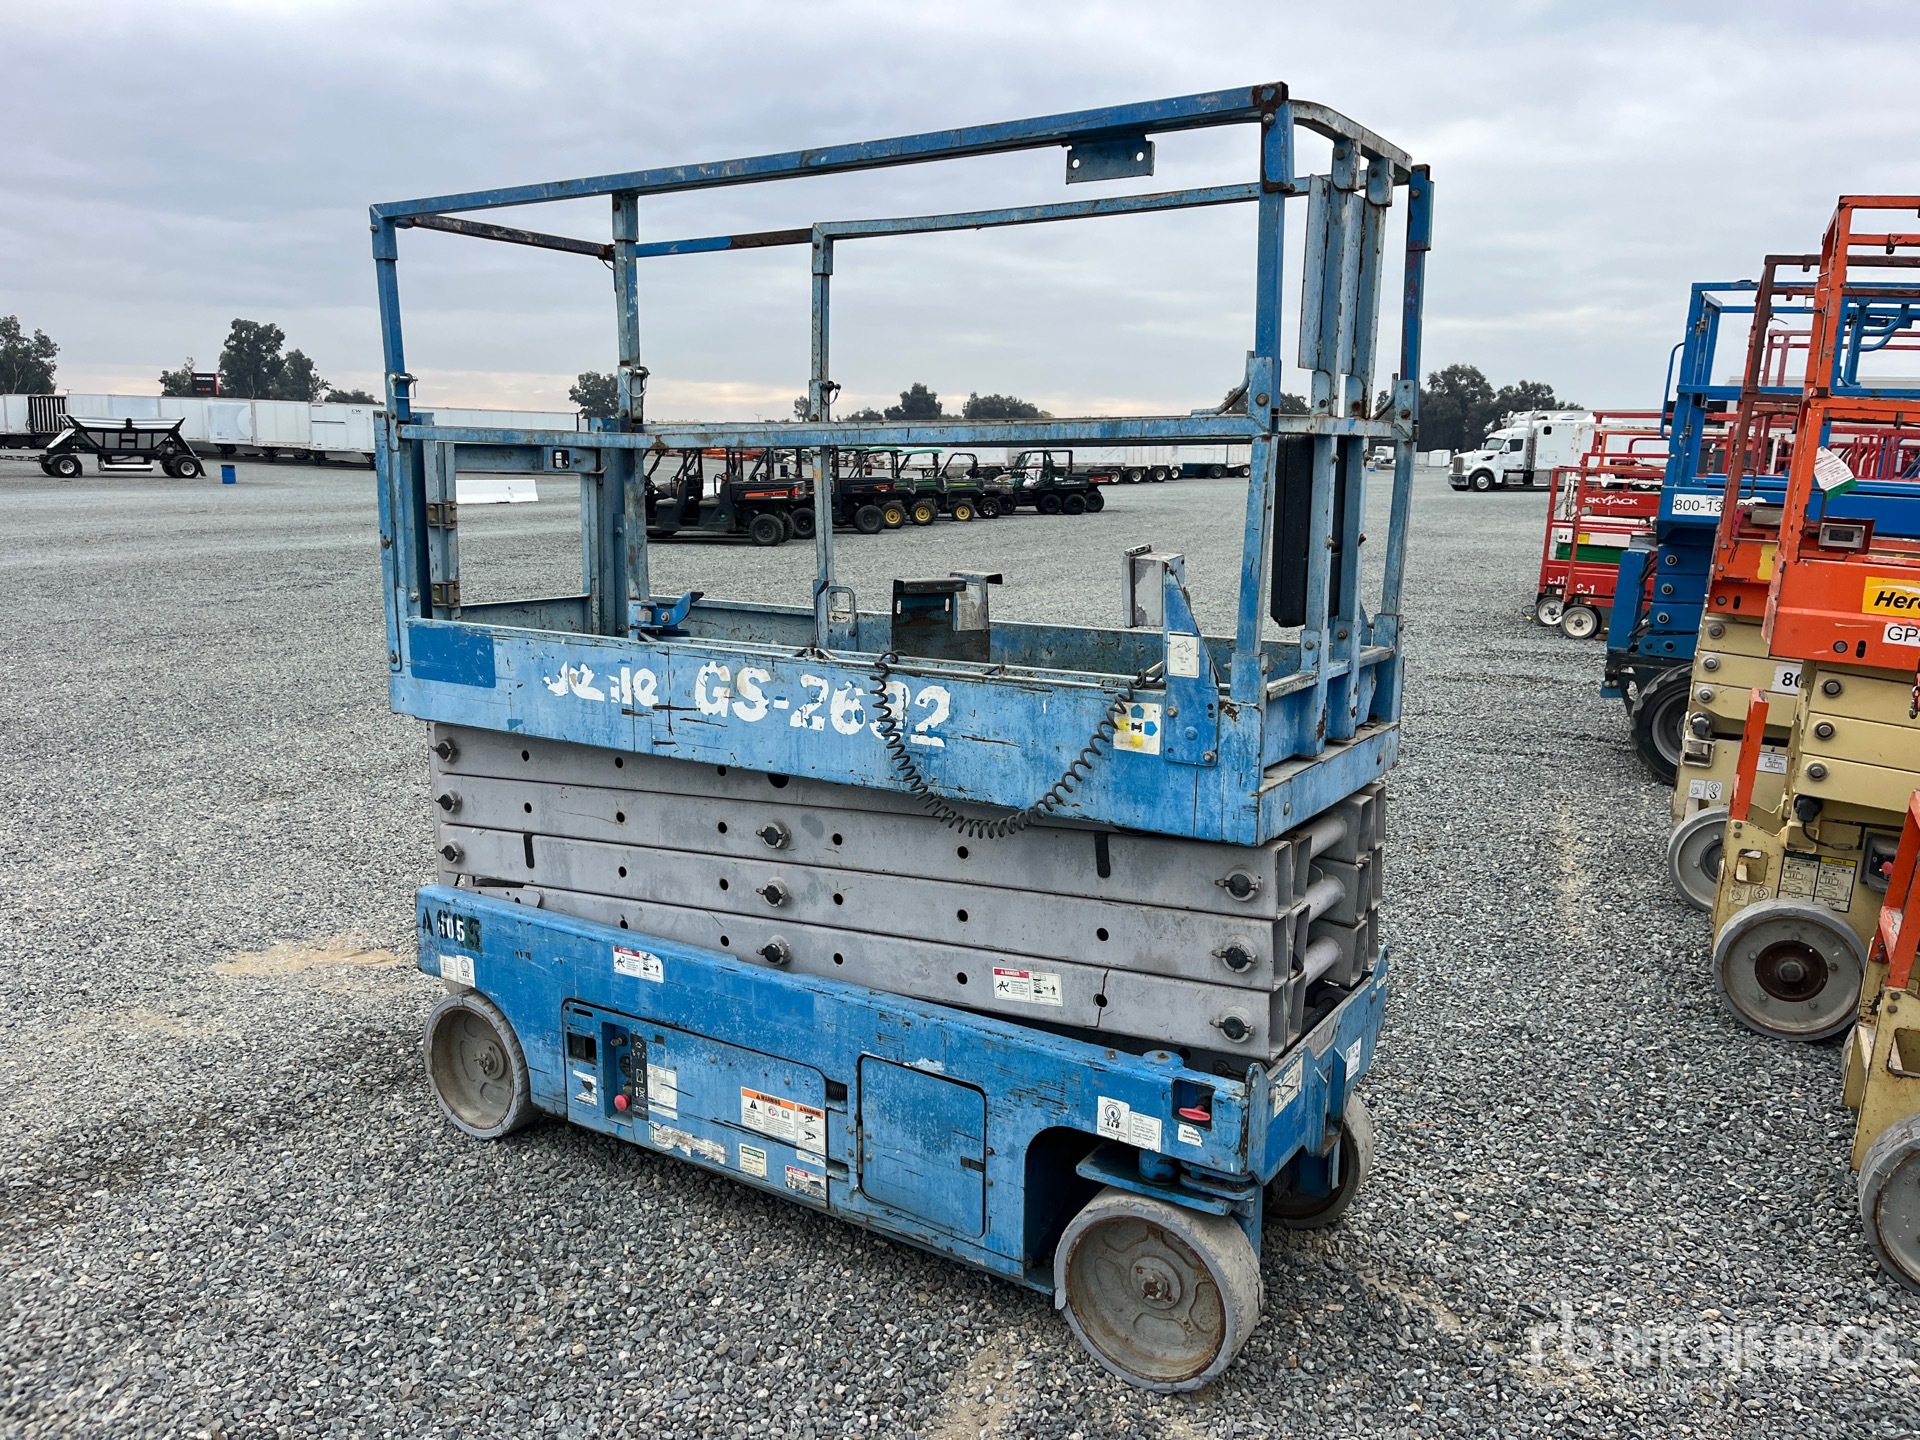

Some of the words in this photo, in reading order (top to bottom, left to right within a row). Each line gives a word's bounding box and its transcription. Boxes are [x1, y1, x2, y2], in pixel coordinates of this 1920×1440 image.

[1584, 494, 1639, 506] SKYJACK
[1673, 499, 1723, 513] 800-13
[1873, 590, 1920, 609] Her
[1887, 625, 1920, 642] GP
[694, 660, 951, 748] GS-2632
[761, 1093, 781, 1106] WARNING
[803, 1108, 821, 1117] WARNING
